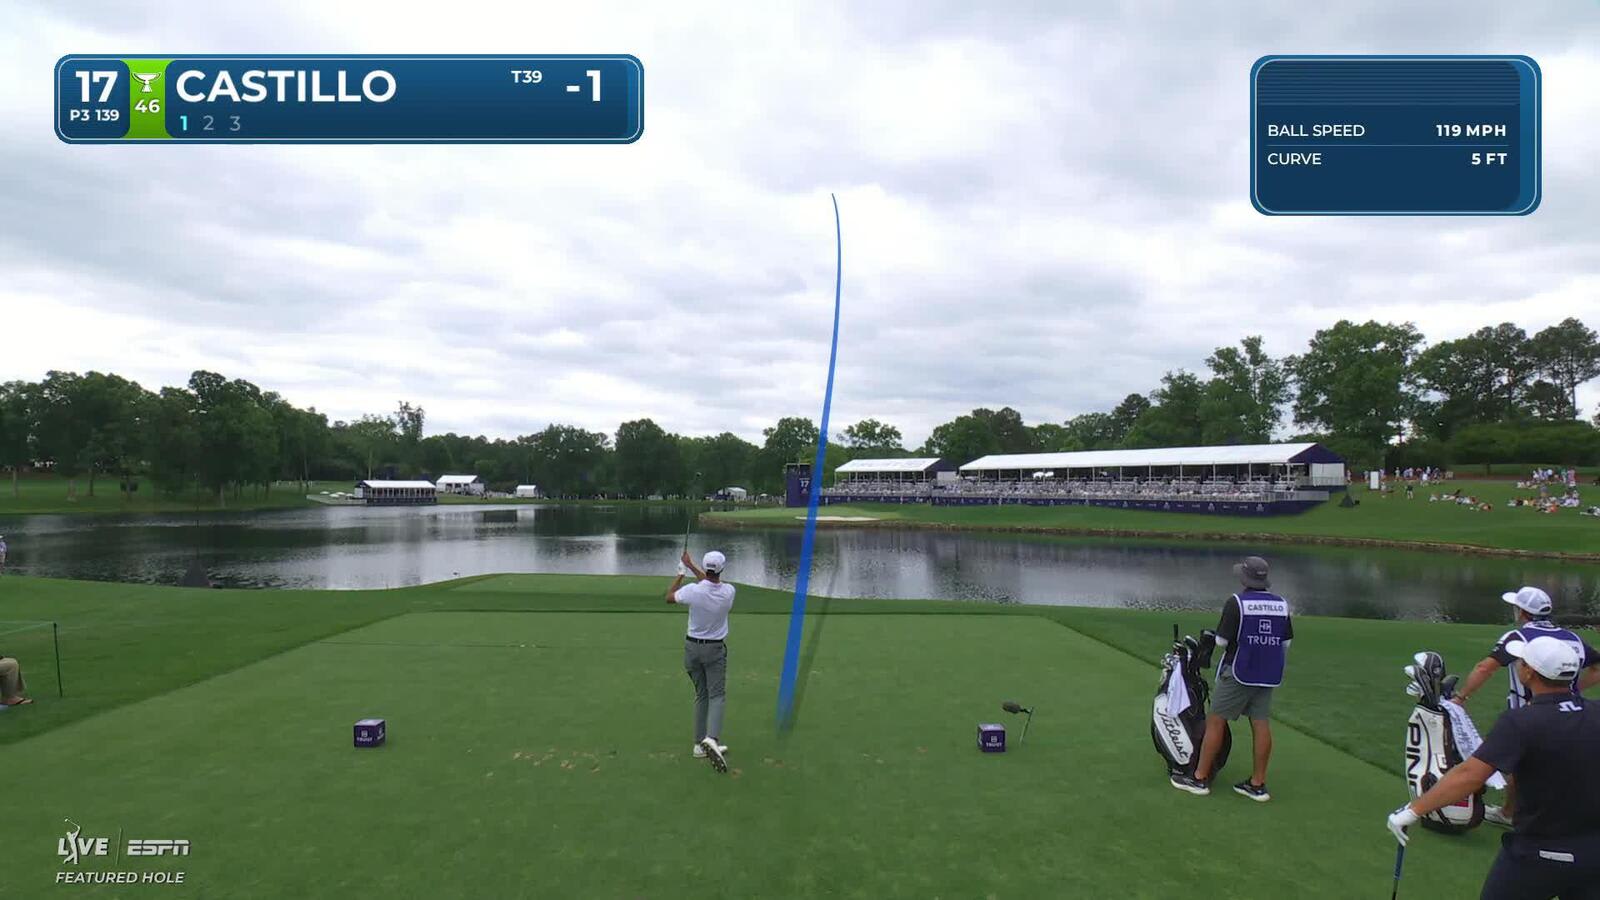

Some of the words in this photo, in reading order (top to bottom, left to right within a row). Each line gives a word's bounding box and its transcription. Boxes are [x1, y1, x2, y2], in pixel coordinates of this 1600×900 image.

[1247, 604, 1284, 612] CASTILLO
[1247, 635, 1281, 646] TRUIST
[1156, 707, 1189, 759] Titleist
